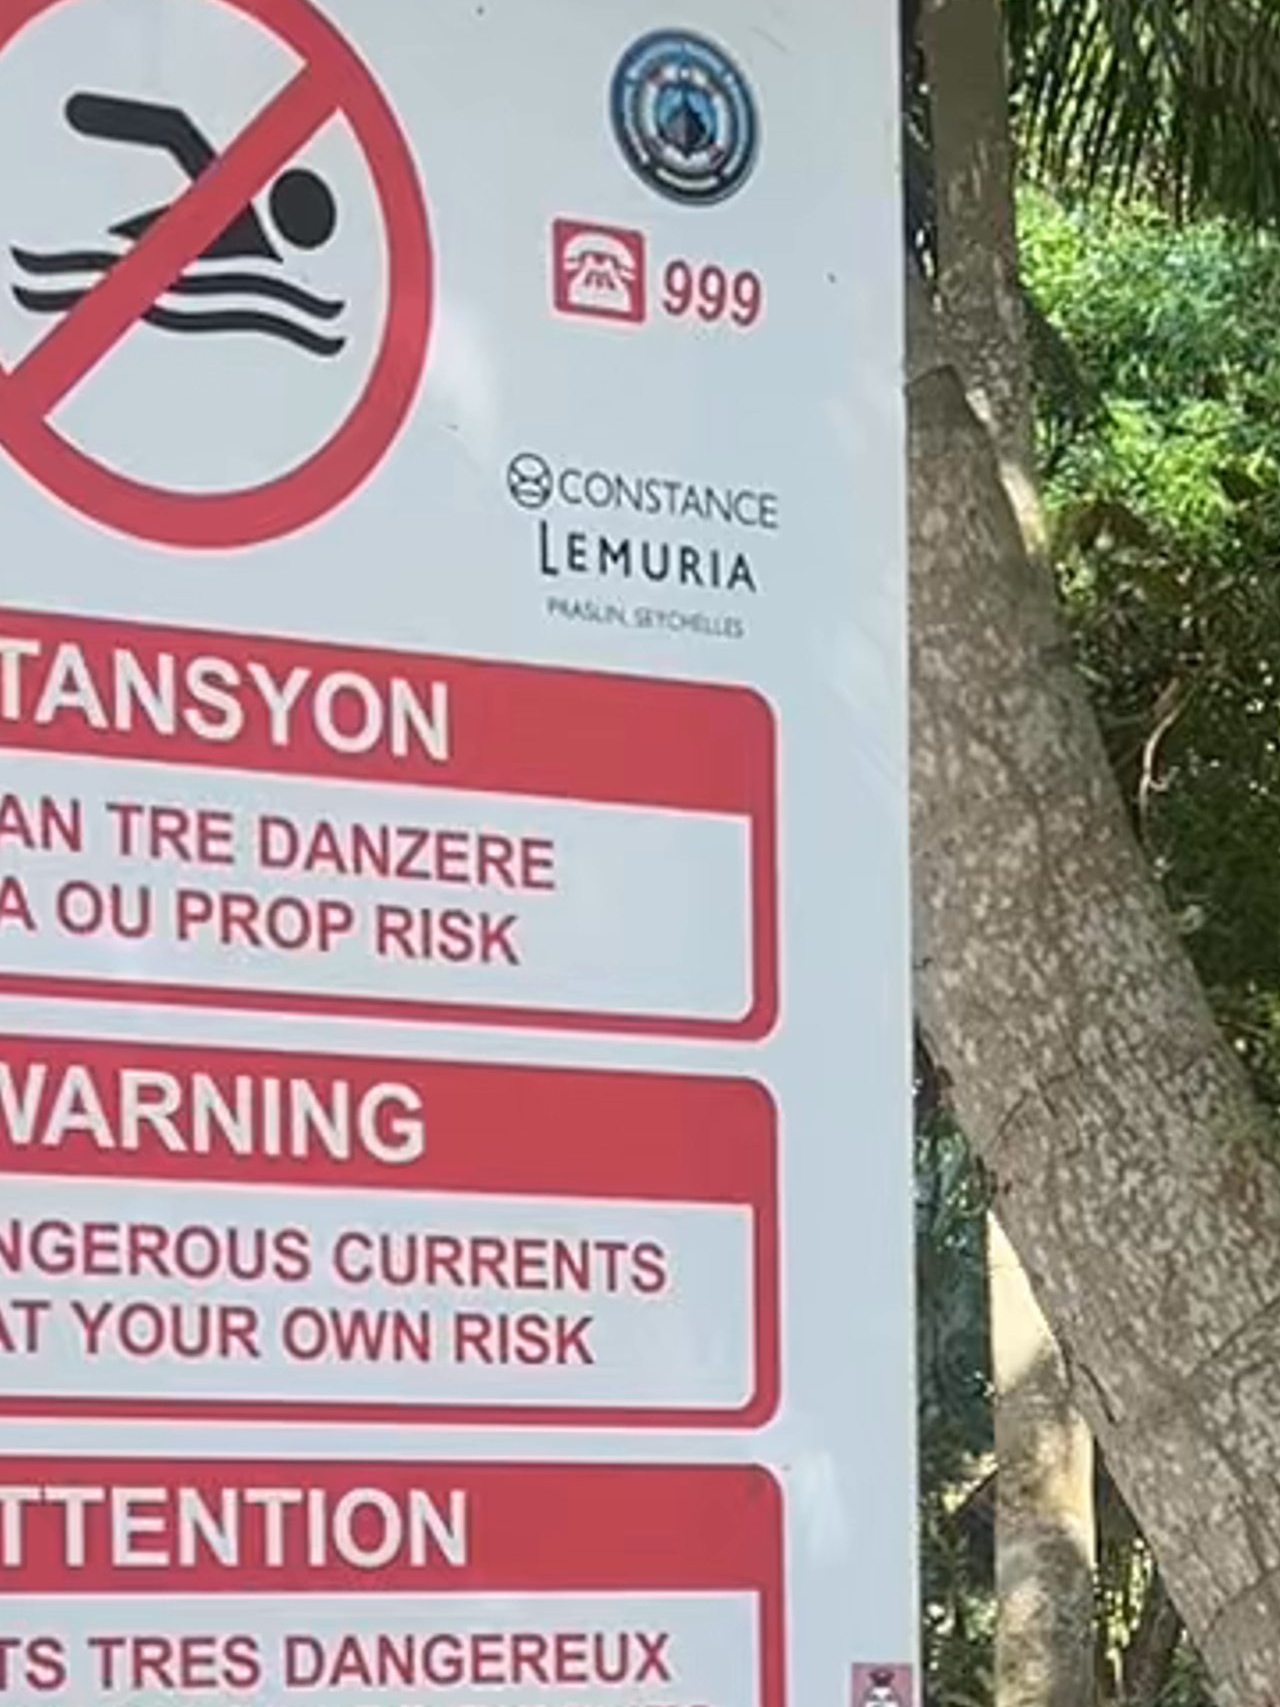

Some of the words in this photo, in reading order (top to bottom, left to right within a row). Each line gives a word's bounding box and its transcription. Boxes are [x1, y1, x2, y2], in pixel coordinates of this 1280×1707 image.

[663, 258, 762, 328] 999
[558, 467, 779, 530] CONSTANCE
[105, 802, 235, 865] TRE
[259, 815, 555, 890] DANZERE
[56, 879, 150, 939] OU
[176, 889, 354, 953] PROP
[376, 904, 519, 966] RISK
[333, 1231, 666, 1294] CURRENTS
[70, 1300, 260, 1359] YOUR
[282, 1306, 431, 1363] OWN
[454, 1312, 595, 1366] RISK
[87, 1635, 261, 1690] TRES
[284, 1632, 670, 1687] DANGEREUX
